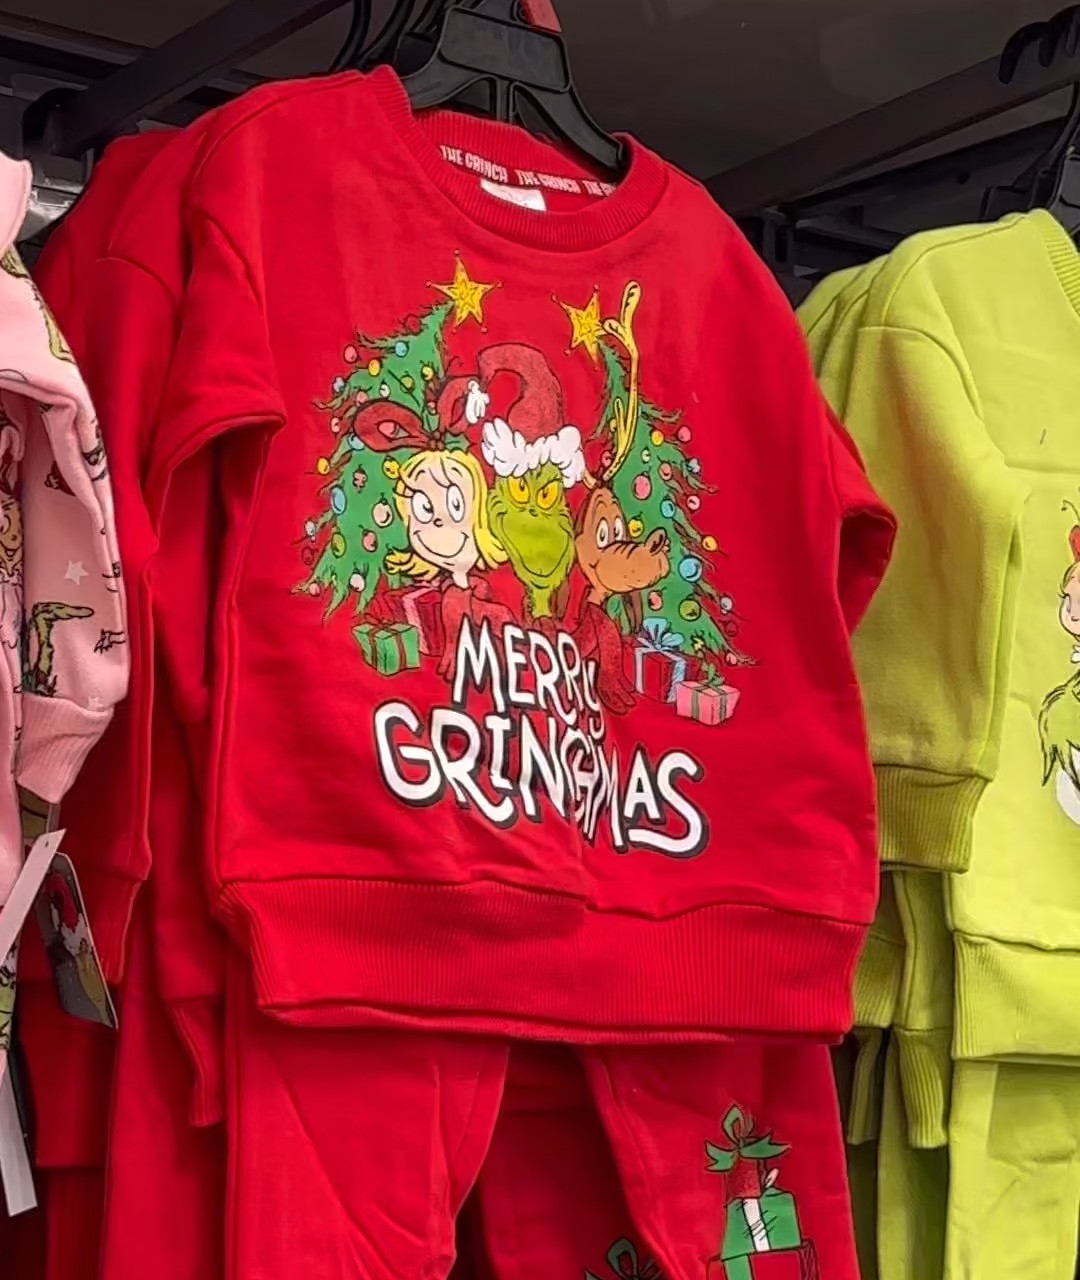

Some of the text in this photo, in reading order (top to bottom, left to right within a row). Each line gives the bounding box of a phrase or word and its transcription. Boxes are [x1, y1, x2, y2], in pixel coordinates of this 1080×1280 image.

[439, 145, 465, 165] THE
[464, 152, 508, 183] GRINCH
[515, 169, 540, 186] THE
[536, 173, 582, 194] GRINCH
[452, 616, 606, 740] MERRY
[374, 700, 709, 859] GRINCHMAS
